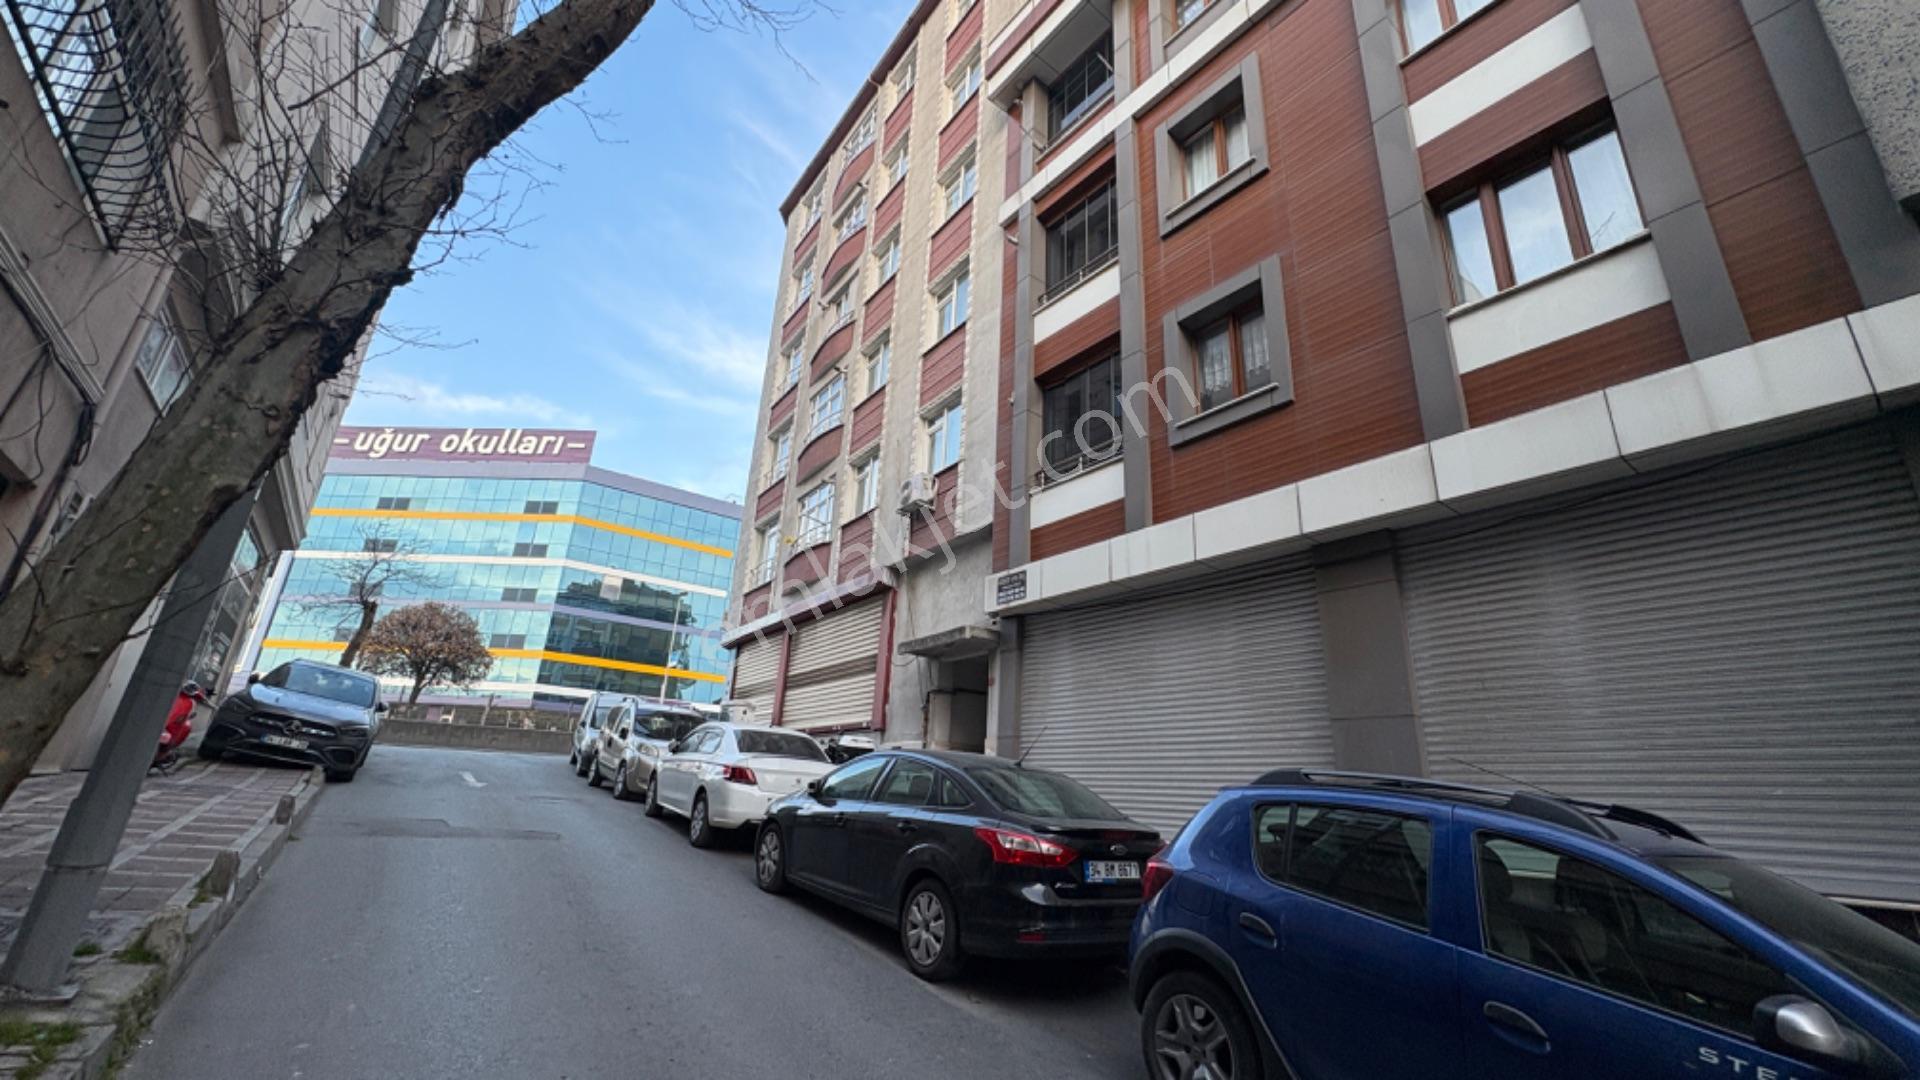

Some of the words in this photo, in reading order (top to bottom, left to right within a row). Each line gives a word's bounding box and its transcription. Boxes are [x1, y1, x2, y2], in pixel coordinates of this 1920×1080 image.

[354, 427, 431, 458] uğur
[439, 427, 564, 456] okulları
[1699, 1047, 1800, 1080] STE
